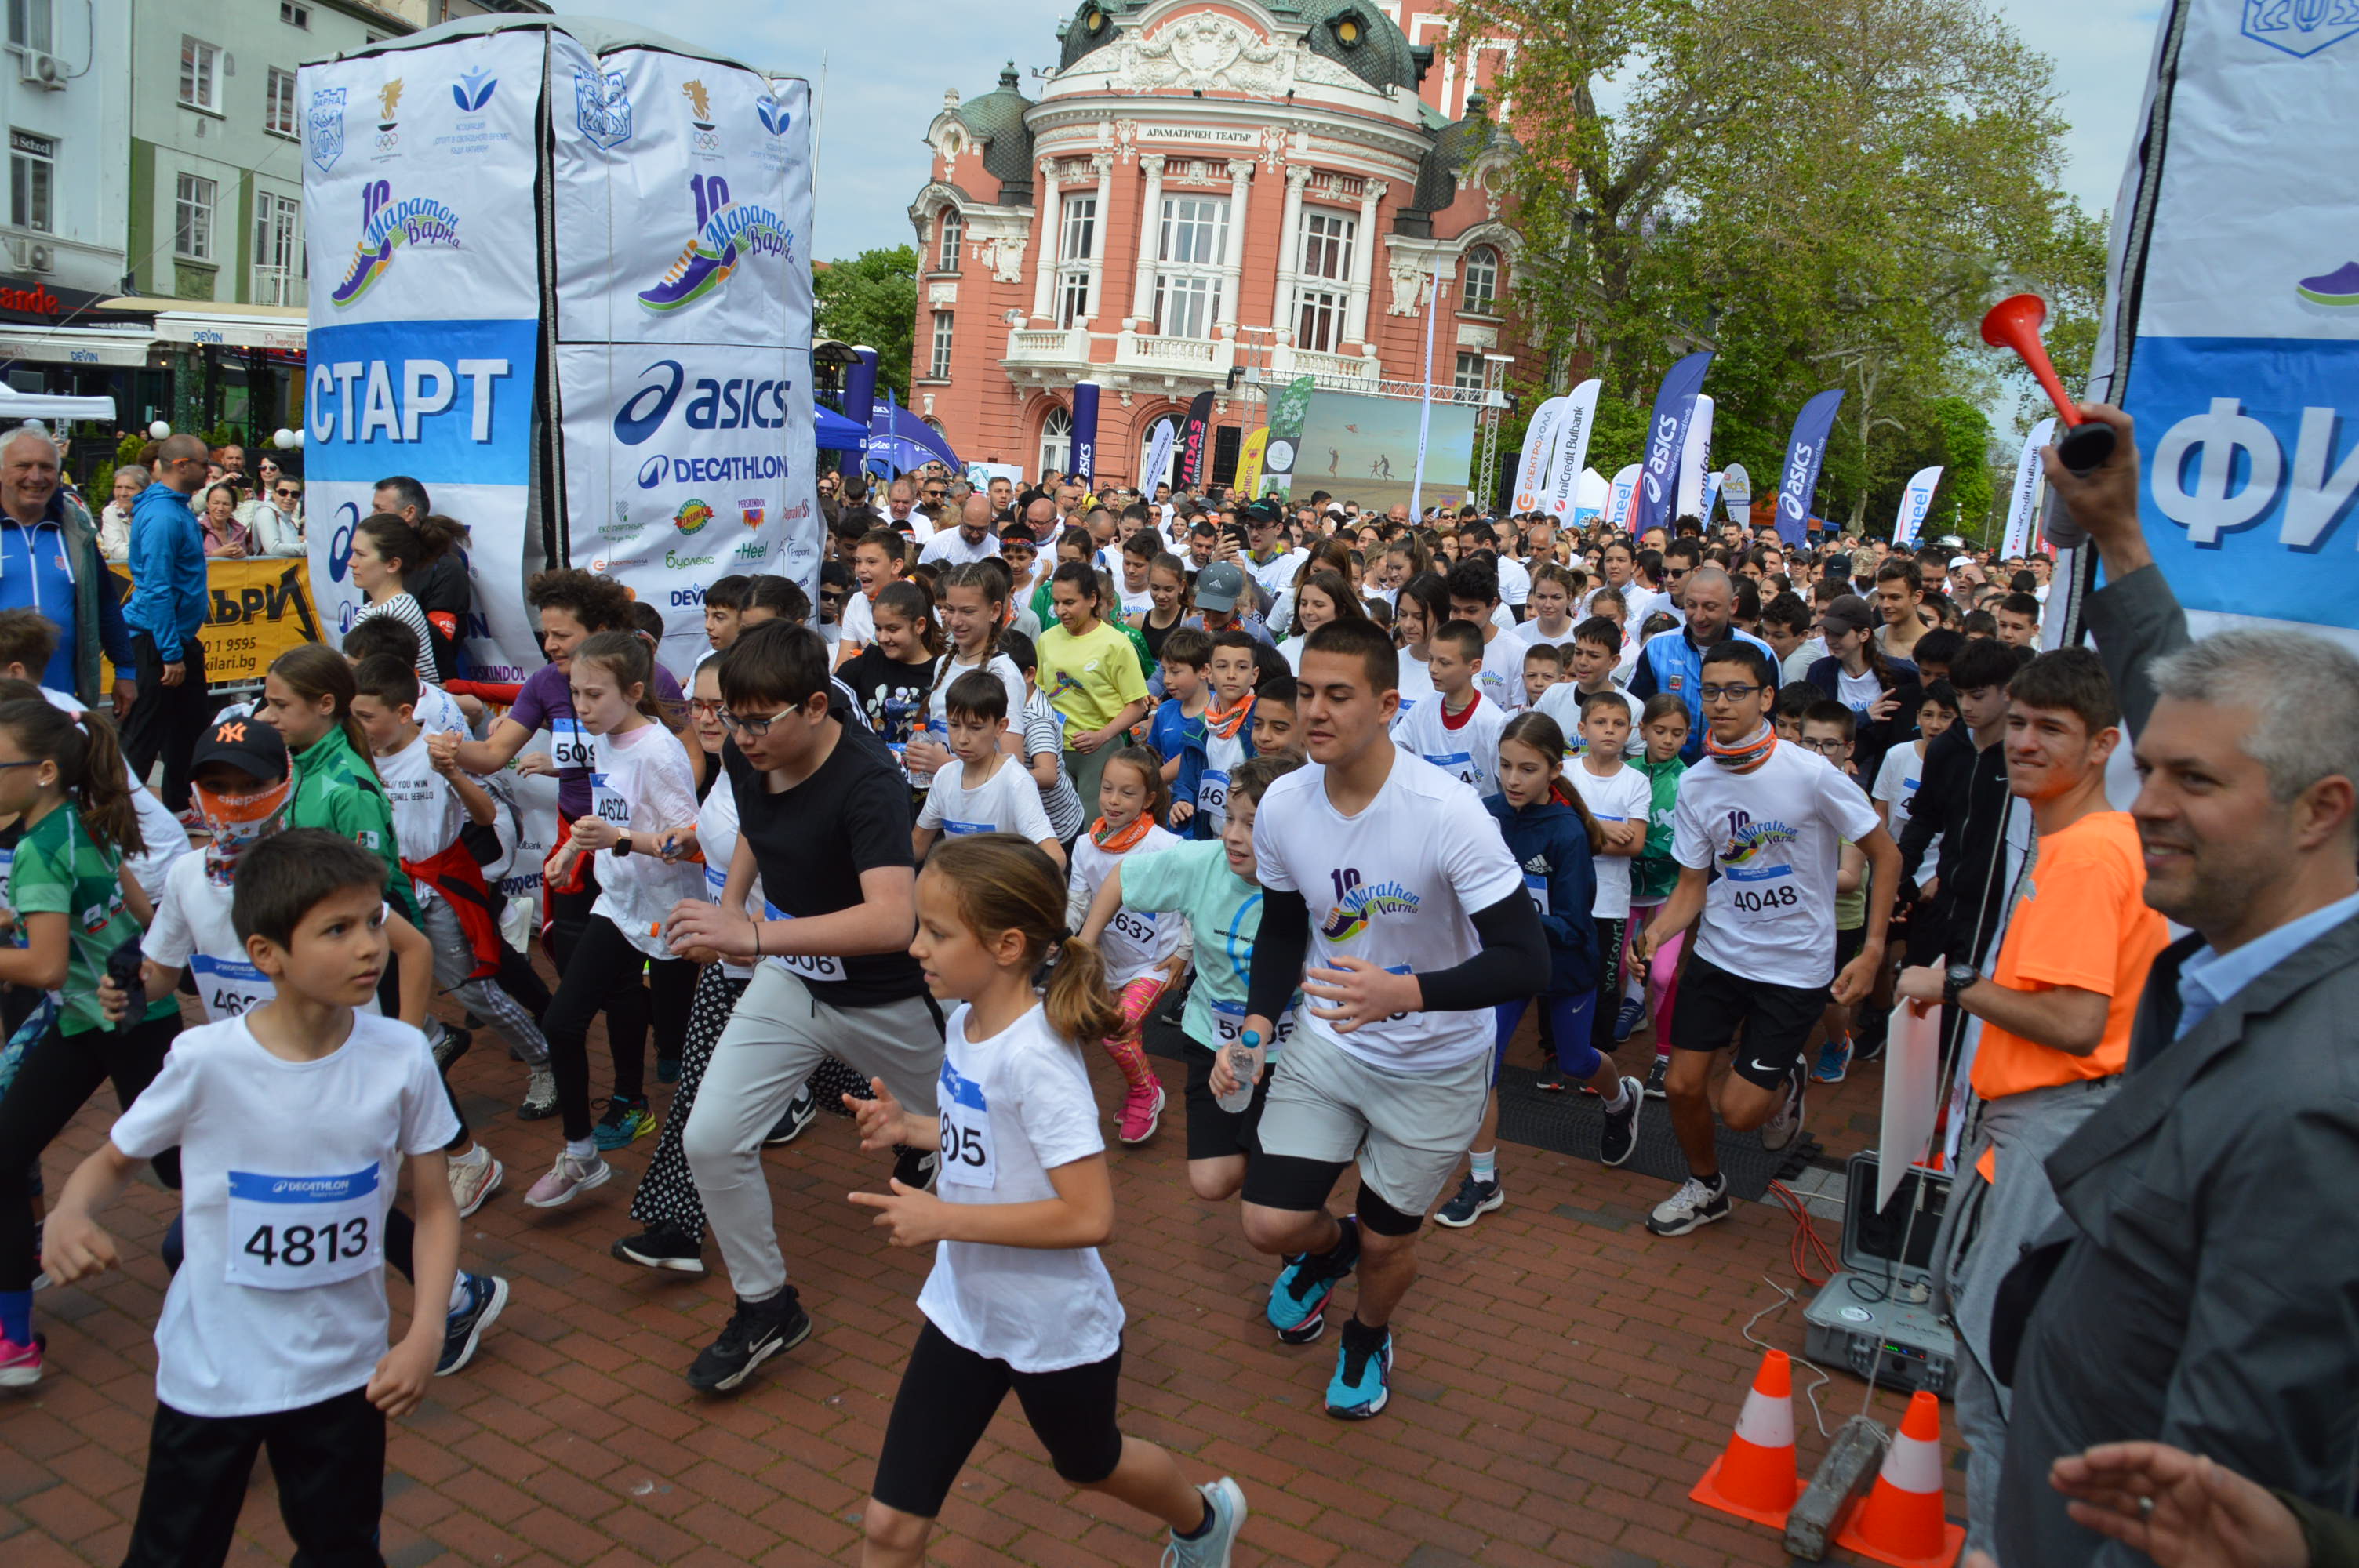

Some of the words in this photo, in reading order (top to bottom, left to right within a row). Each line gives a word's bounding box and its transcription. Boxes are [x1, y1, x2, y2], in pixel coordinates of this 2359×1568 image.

[1147, 128, 1211, 140] ДРАМАТИЧЕН
[1215, 131, 1251, 142] ТЕАТЪР
[362, 180, 391, 236] 10
[690, 173, 730, 235] 10
[368, 197, 460, 250] Маратон
[403, 217, 460, 249] Варна
[706, 205, 794, 255] Маратон
[747, 225, 794, 265] Варна
[194, 329, 223, 343] DEVIN
[71, 349, 98, 362] DEVIN
[310, 358, 511, 445] СТАРТ
[1566, 406, 1584, 450] Bulbank
[1649, 413, 1677, 474] asics
[674, 455, 788, 484] DECATHLON
[1079, 442, 1091, 477] asics
[1194, 450, 1203, 484] NATURAL
[1787, 441, 1812, 496] asics
[1557, 451, 1576, 499] UniCredit
[738, 498, 766, 509] PERSKINDOL
[791, 548, 810, 559] Fraport
[671, 588, 707, 607] DEVI
[225, 637, 256, 652] 9595
[556, 742, 595, 763] 509
[598, 798, 630, 822] 4622
[1199, 786, 1226, 809] 46
[1728, 811, 1750, 837] 10
[1736, 820, 1799, 843] Marathon
[1763, 833, 1796, 845] Varna
[1525, 863, 1554, 874] adidas
[1331, 868, 1361, 905] 10
[1343, 880, 1420, 913] Marathon
[1734, 885, 1798, 913] 4048
[1373, 898, 1419, 916] Varna
[1108, 912, 1155, 944] 637
[288, 1180, 350, 1192] DECATHLON
[244, 1216, 369, 1267] 4813
